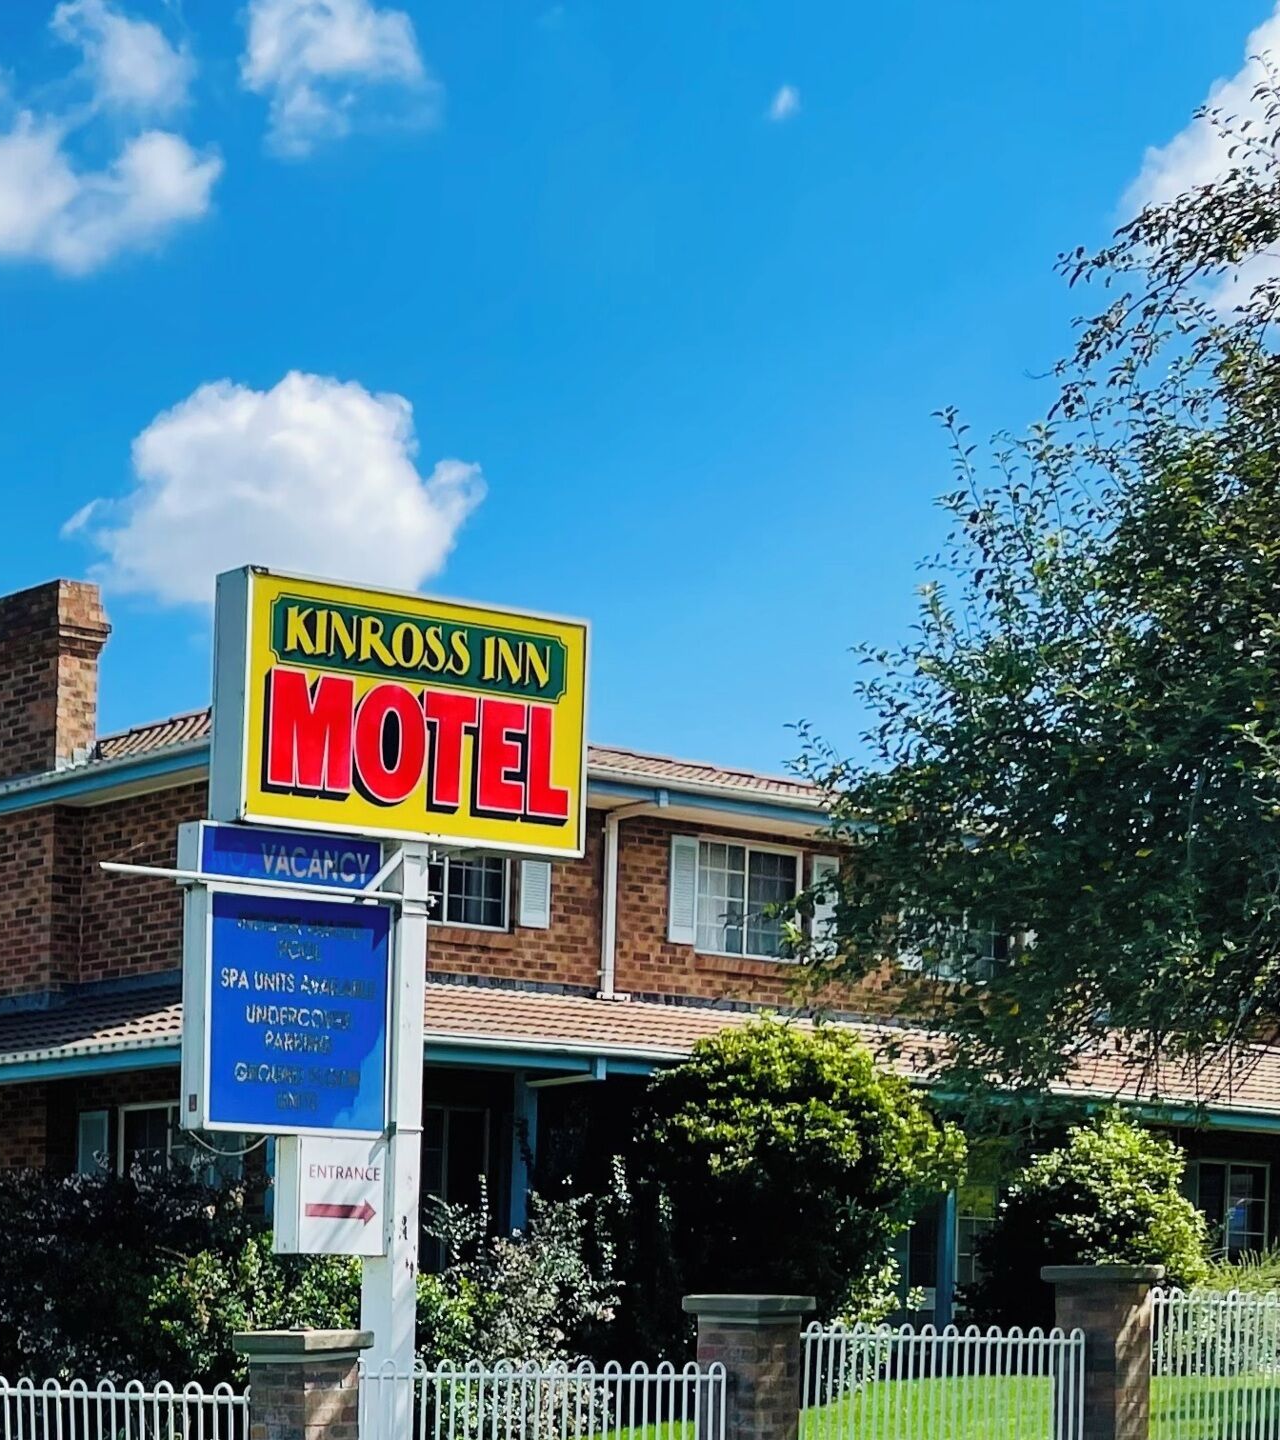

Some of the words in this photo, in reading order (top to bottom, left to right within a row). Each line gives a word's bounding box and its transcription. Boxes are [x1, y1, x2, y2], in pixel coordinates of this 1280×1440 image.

[284, 605, 471, 675] KINROSS
[482, 635, 551, 688] INN
[263, 667, 570, 823] MOTEL
[261, 843, 371, 884] VACANCY
[220, 966, 249, 989] SPA
[254, 970, 296, 993] UNITS
[308, 1164, 381, 1182] ENTRANCE
